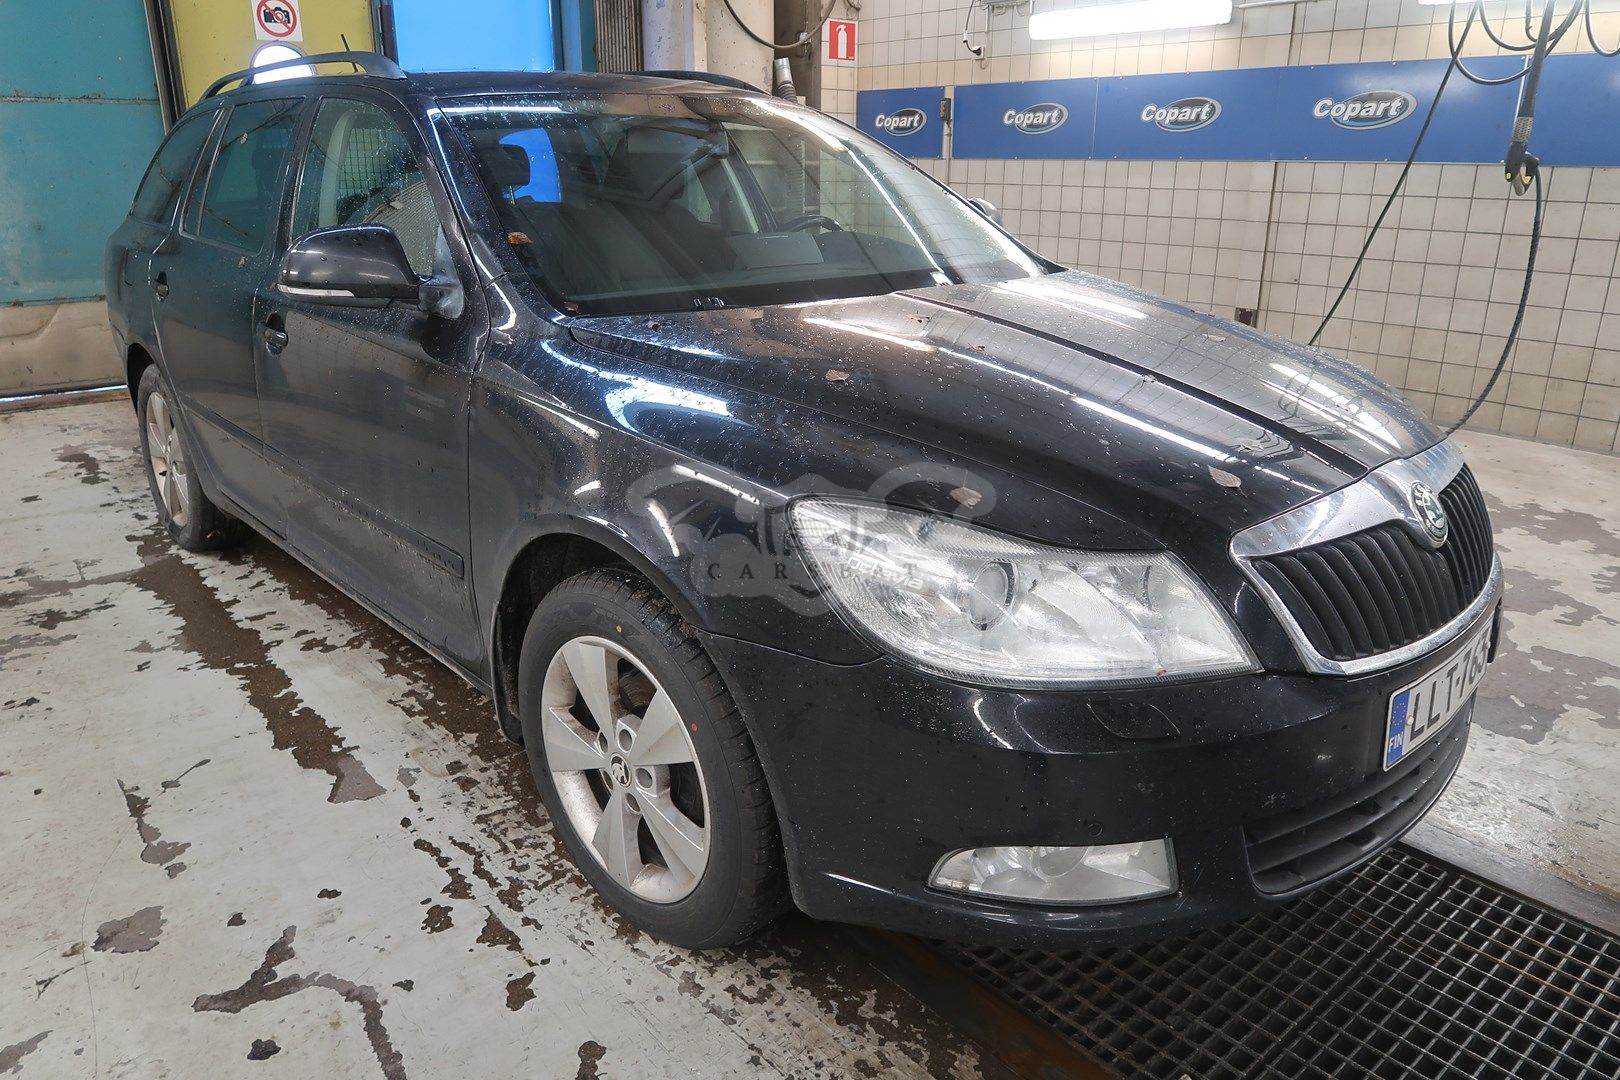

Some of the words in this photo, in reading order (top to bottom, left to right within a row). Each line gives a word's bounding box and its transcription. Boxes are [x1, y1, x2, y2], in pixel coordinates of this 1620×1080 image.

[1003, 108, 1059, 128] Copart
[1141, 104, 1210, 125] Copart
[1313, 97, 1402, 121] Copart
[875, 113, 920, 130] Copart
[1388, 731, 1404, 752] FIN
